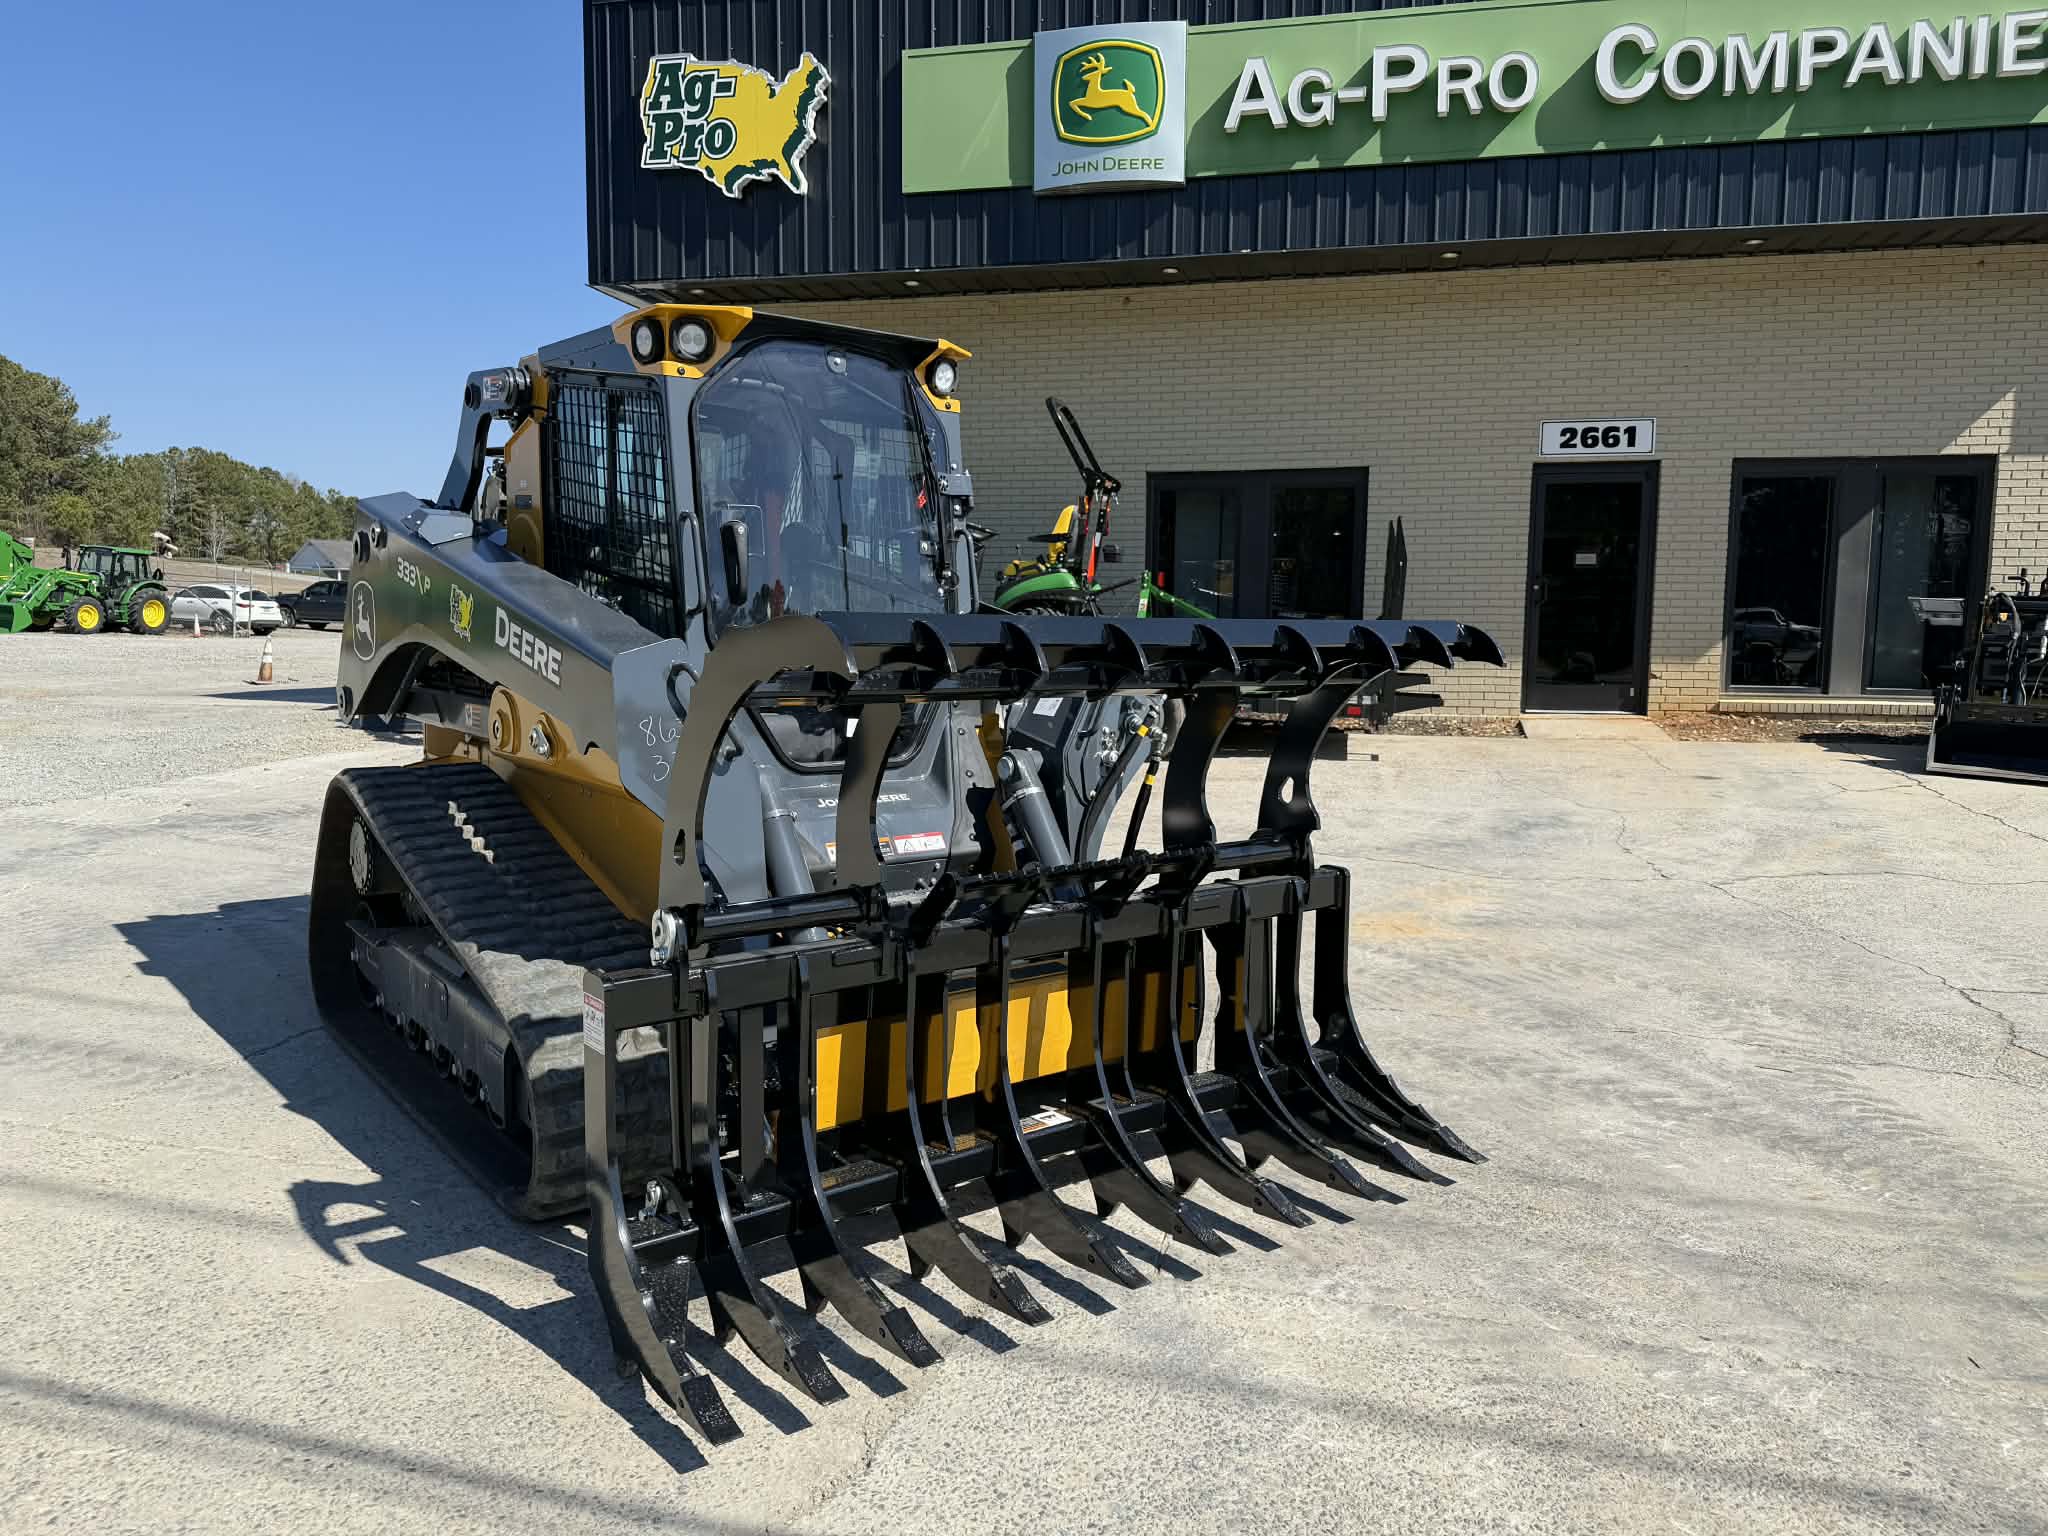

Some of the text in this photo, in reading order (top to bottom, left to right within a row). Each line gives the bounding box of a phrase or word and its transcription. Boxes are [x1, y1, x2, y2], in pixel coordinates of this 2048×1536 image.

[646, 58, 737, 121] Ag-
[643, 110, 737, 167] Pro
[1051, 157, 1165, 176] JOHN DEERE
[1559, 426, 1637, 449] 2661
[495, 606, 562, 686] DEERE
